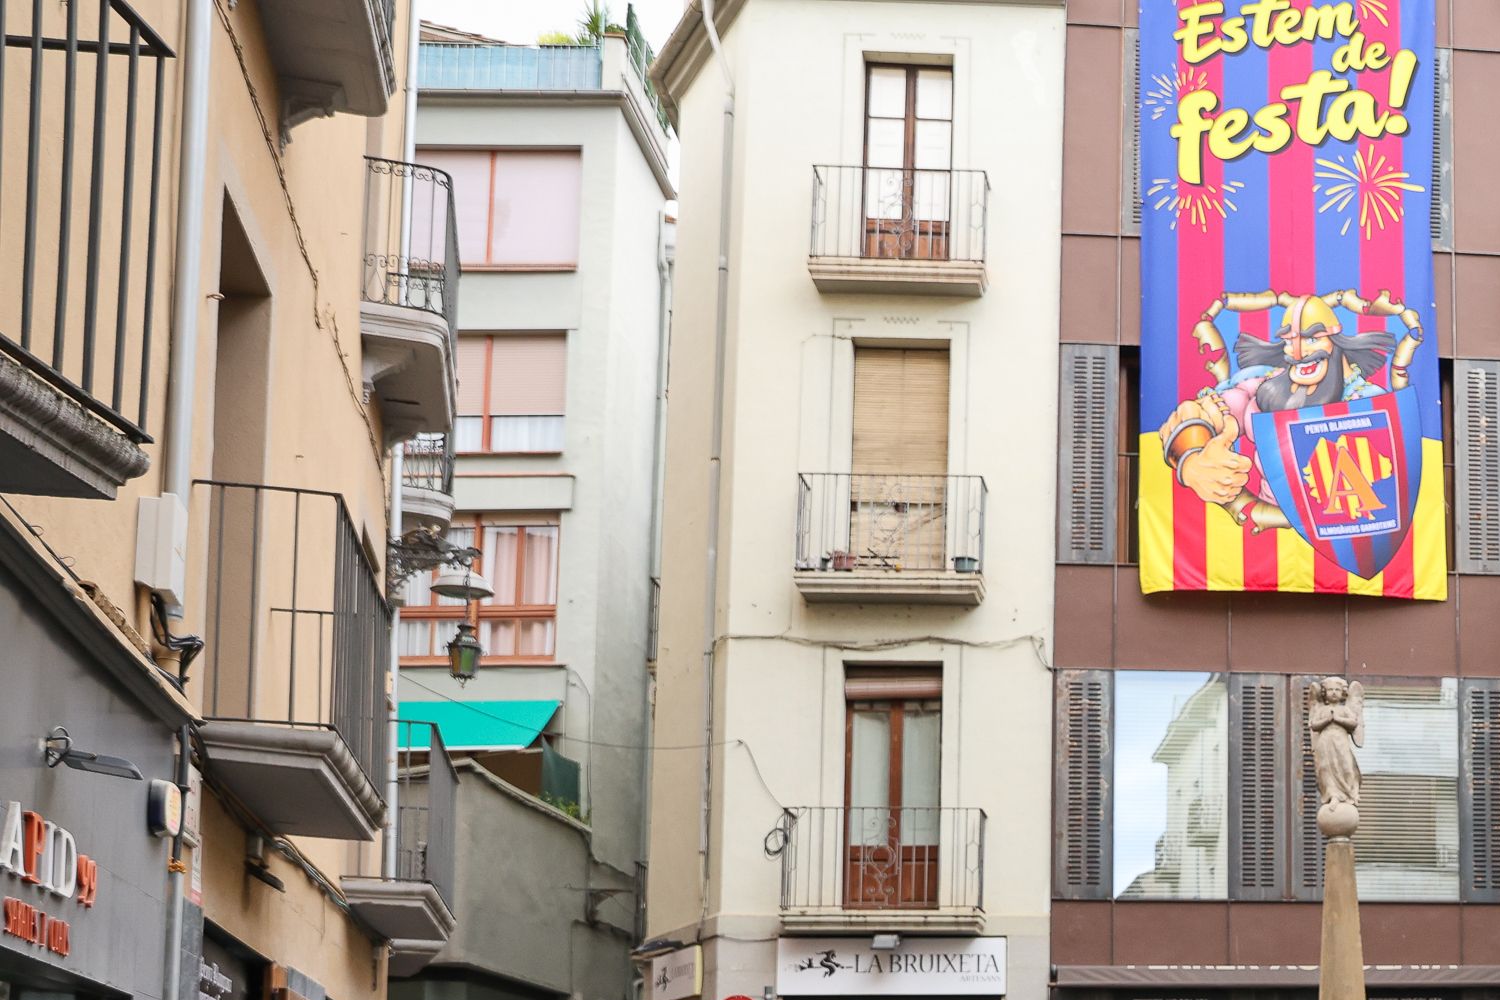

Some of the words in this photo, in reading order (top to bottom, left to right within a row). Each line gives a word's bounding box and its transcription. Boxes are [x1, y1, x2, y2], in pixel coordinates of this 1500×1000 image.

[1173, 0, 1359, 64] Estem
[1332, 32, 1391, 73] de
[1169, 49, 1417, 185] festa!
[855, 953, 884, 974] LA
[889, 953, 1000, 974] BRUIXETA
